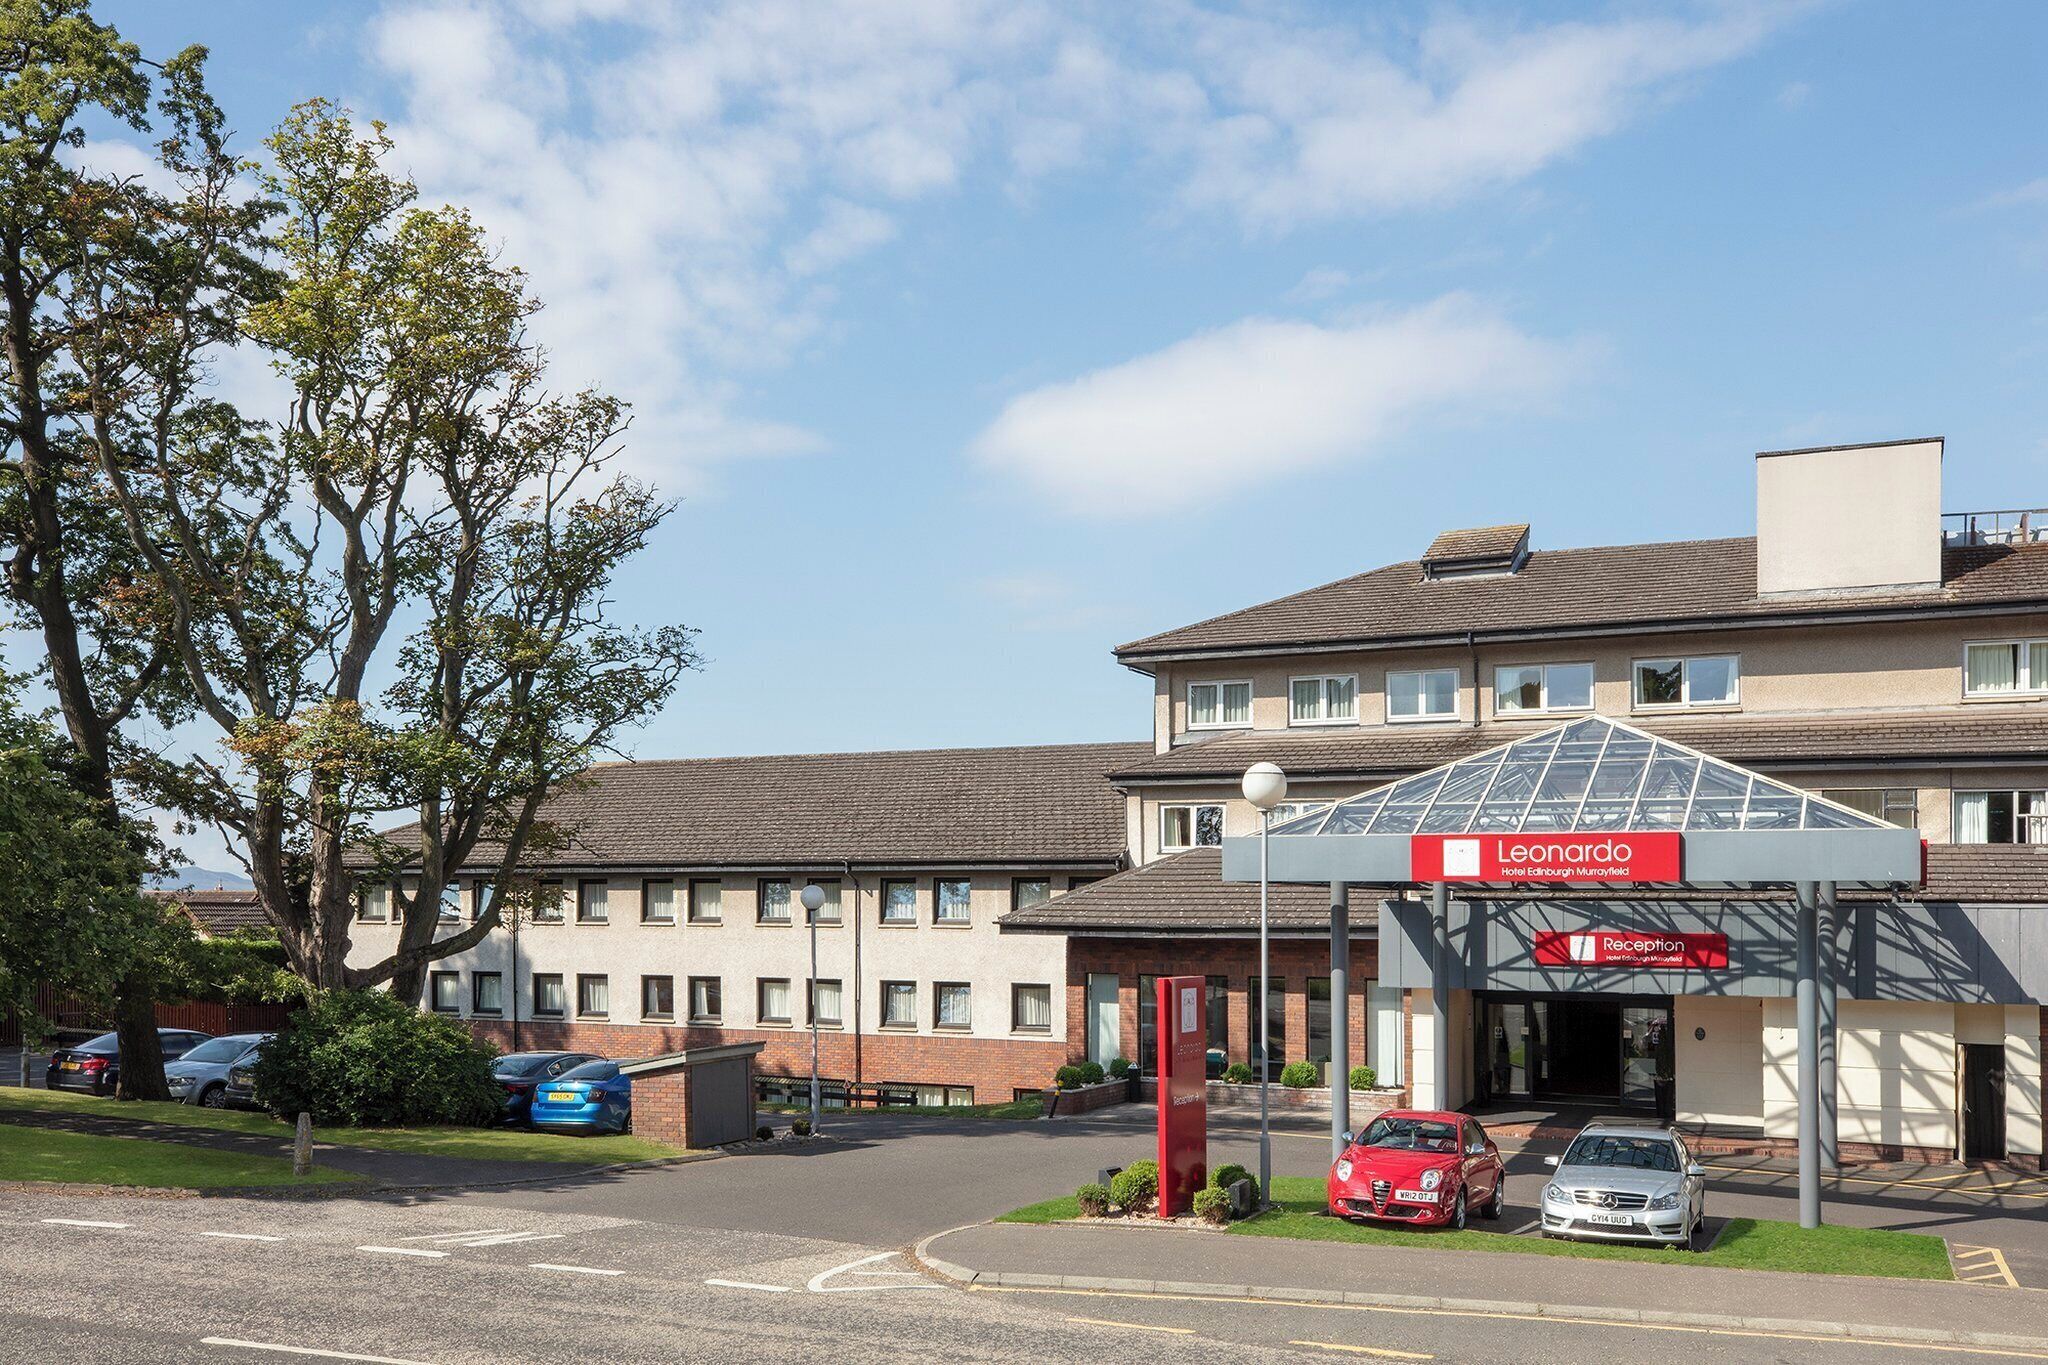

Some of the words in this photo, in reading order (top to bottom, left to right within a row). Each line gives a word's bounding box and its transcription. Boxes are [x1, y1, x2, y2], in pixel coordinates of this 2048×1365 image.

[1498, 839, 1632, 862] Leonardo
[1501, 867, 1525, 876] Hotel
[1527, 867, 1574, 878] Edinburgh
[1576, 867, 1629, 877] Murrayfield
[1603, 938, 1685, 953] Reception
[1173, 1094, 1194, 1106] Reception
[1400, 1191, 1416, 1200] WR12
[1418, 1193, 1433, 1201] OTJ
[1591, 1214, 1609, 1222] GY14
